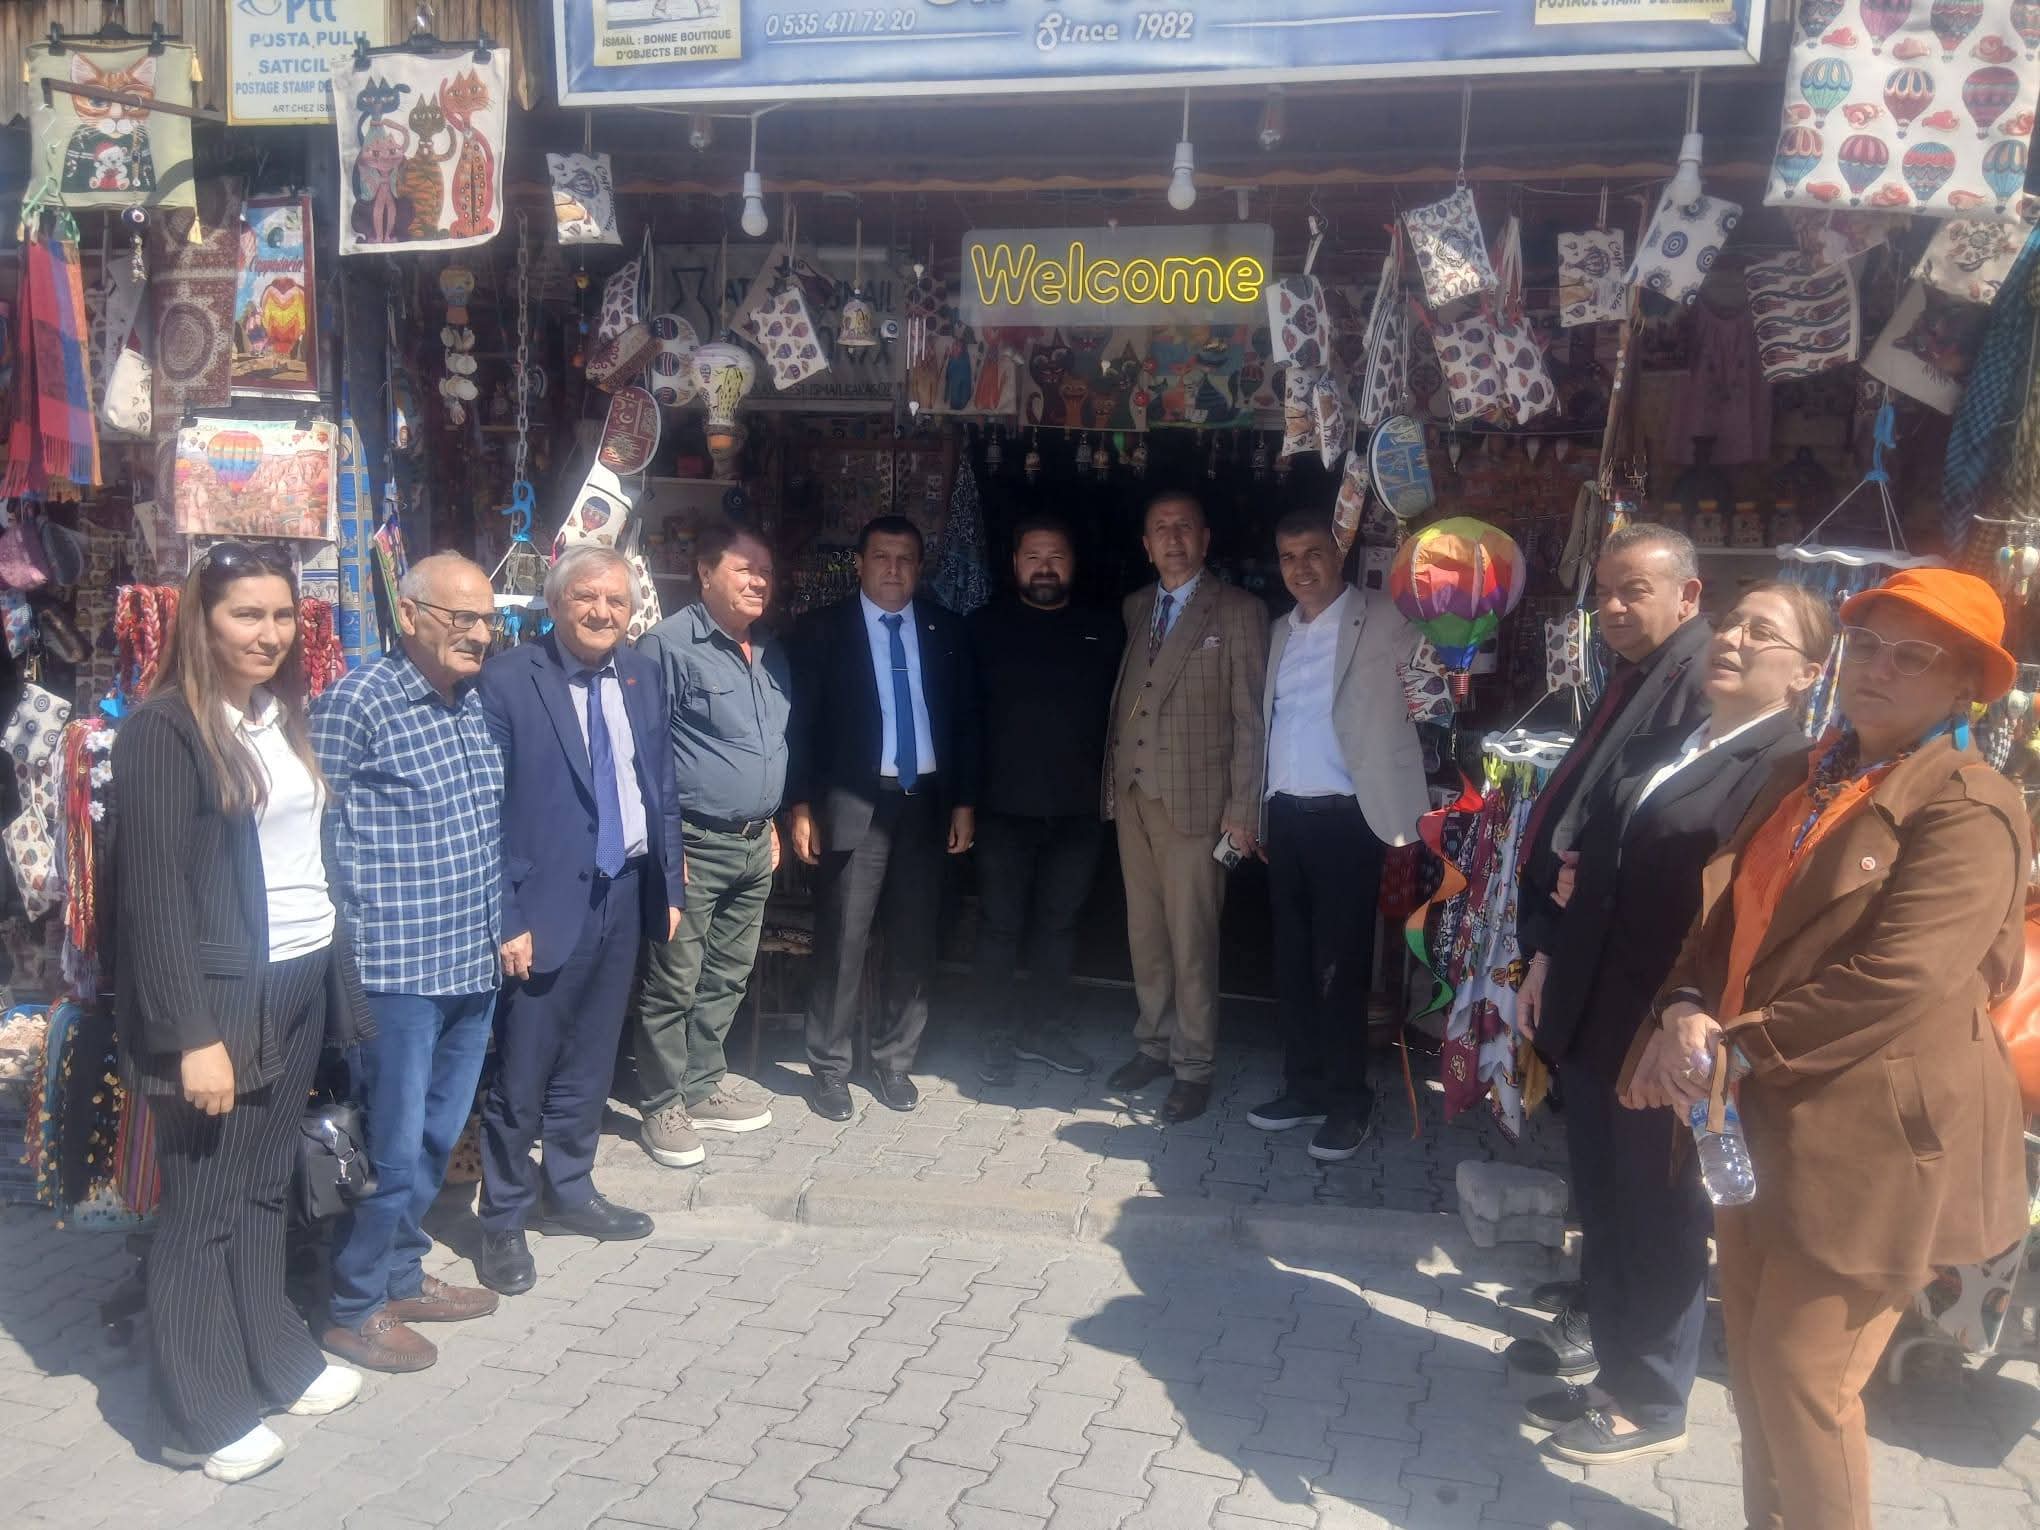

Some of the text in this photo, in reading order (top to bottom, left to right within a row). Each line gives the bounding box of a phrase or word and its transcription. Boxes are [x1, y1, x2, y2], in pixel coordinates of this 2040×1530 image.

[766, 15, 780, 36] 0
[783, 13, 819, 35] 535
[862, 9, 885, 32] 72
[890, 9, 916, 31] 20
[249, 31, 310, 48] POSTA
[643, 33, 678, 45] BONNE
[680, 29, 732, 42] BOUTIQUE
[1036, 12, 1194, 51] Since 1982
[616, 45, 718, 60] D'OBJECTS EN ONYX
[258, 57, 330, 75] SATICIL
[235, 80, 279, 96] POSTAGE
[282, 79, 315, 94] STAMP
[970, 241, 1264, 305] Welcome
